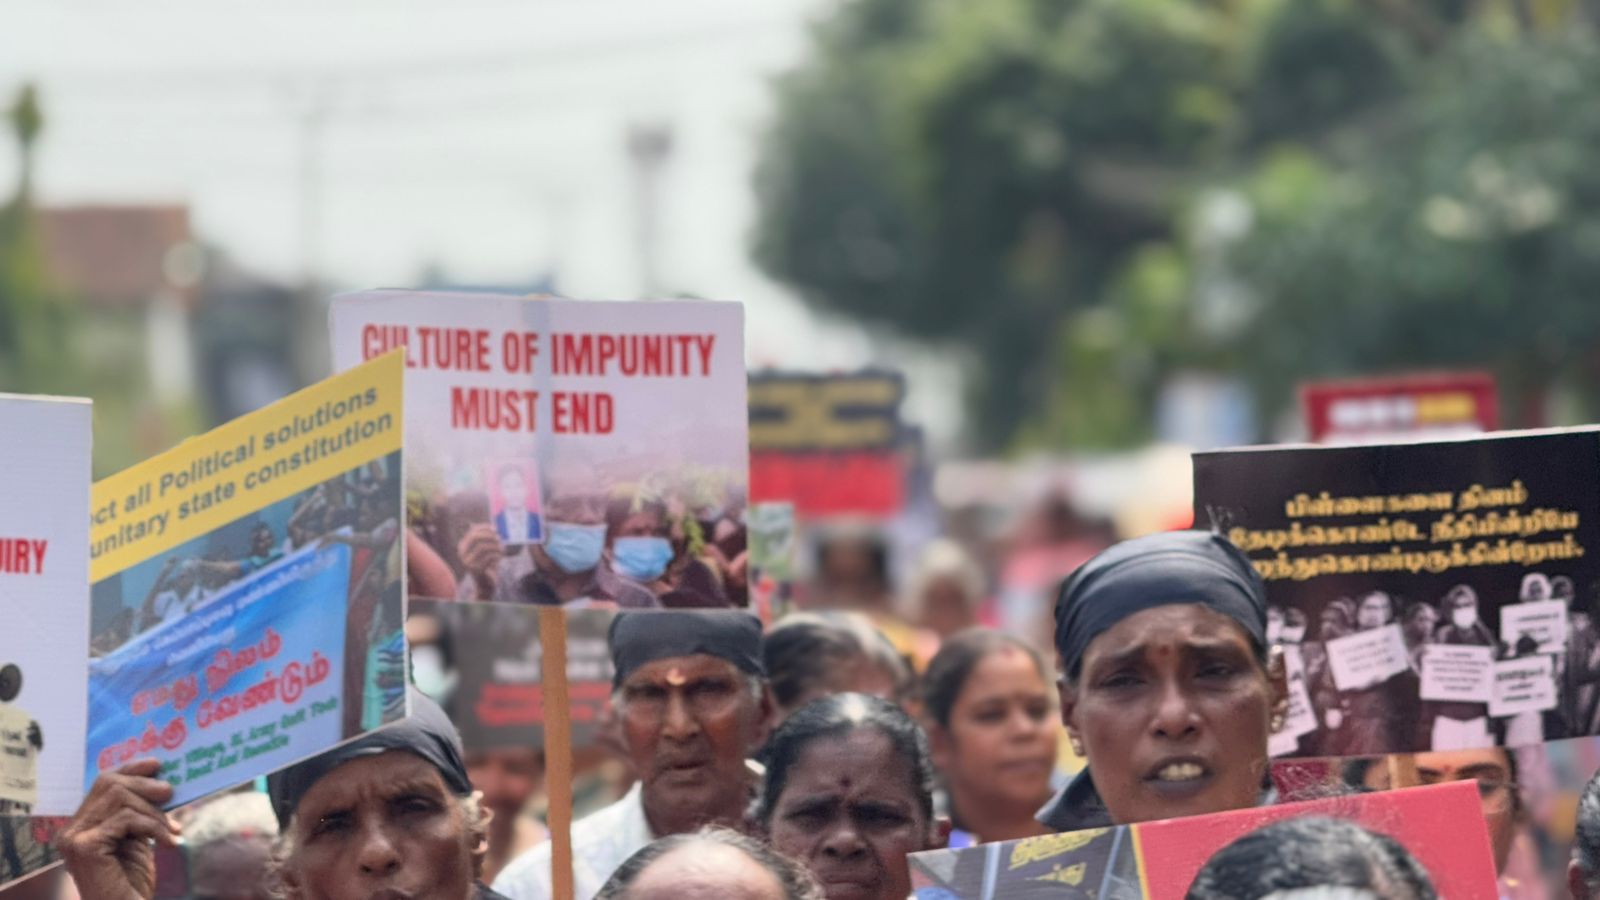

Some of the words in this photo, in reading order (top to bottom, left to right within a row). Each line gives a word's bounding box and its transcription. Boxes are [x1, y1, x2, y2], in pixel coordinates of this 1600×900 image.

[362, 323, 491, 371] CULTURE
[502, 331, 539, 374] OF
[551, 334, 715, 377] IMPUNITY
[452, 387, 539, 432] MUST
[552, 392, 615, 434] END
[89, 499, 117, 526] ct
[124, 481, 151, 512] all
[159, 436, 255, 497] Political
[262, 386, 377, 450] solutions
[177, 482, 236, 519] state
[243, 411, 393, 489] constitution
